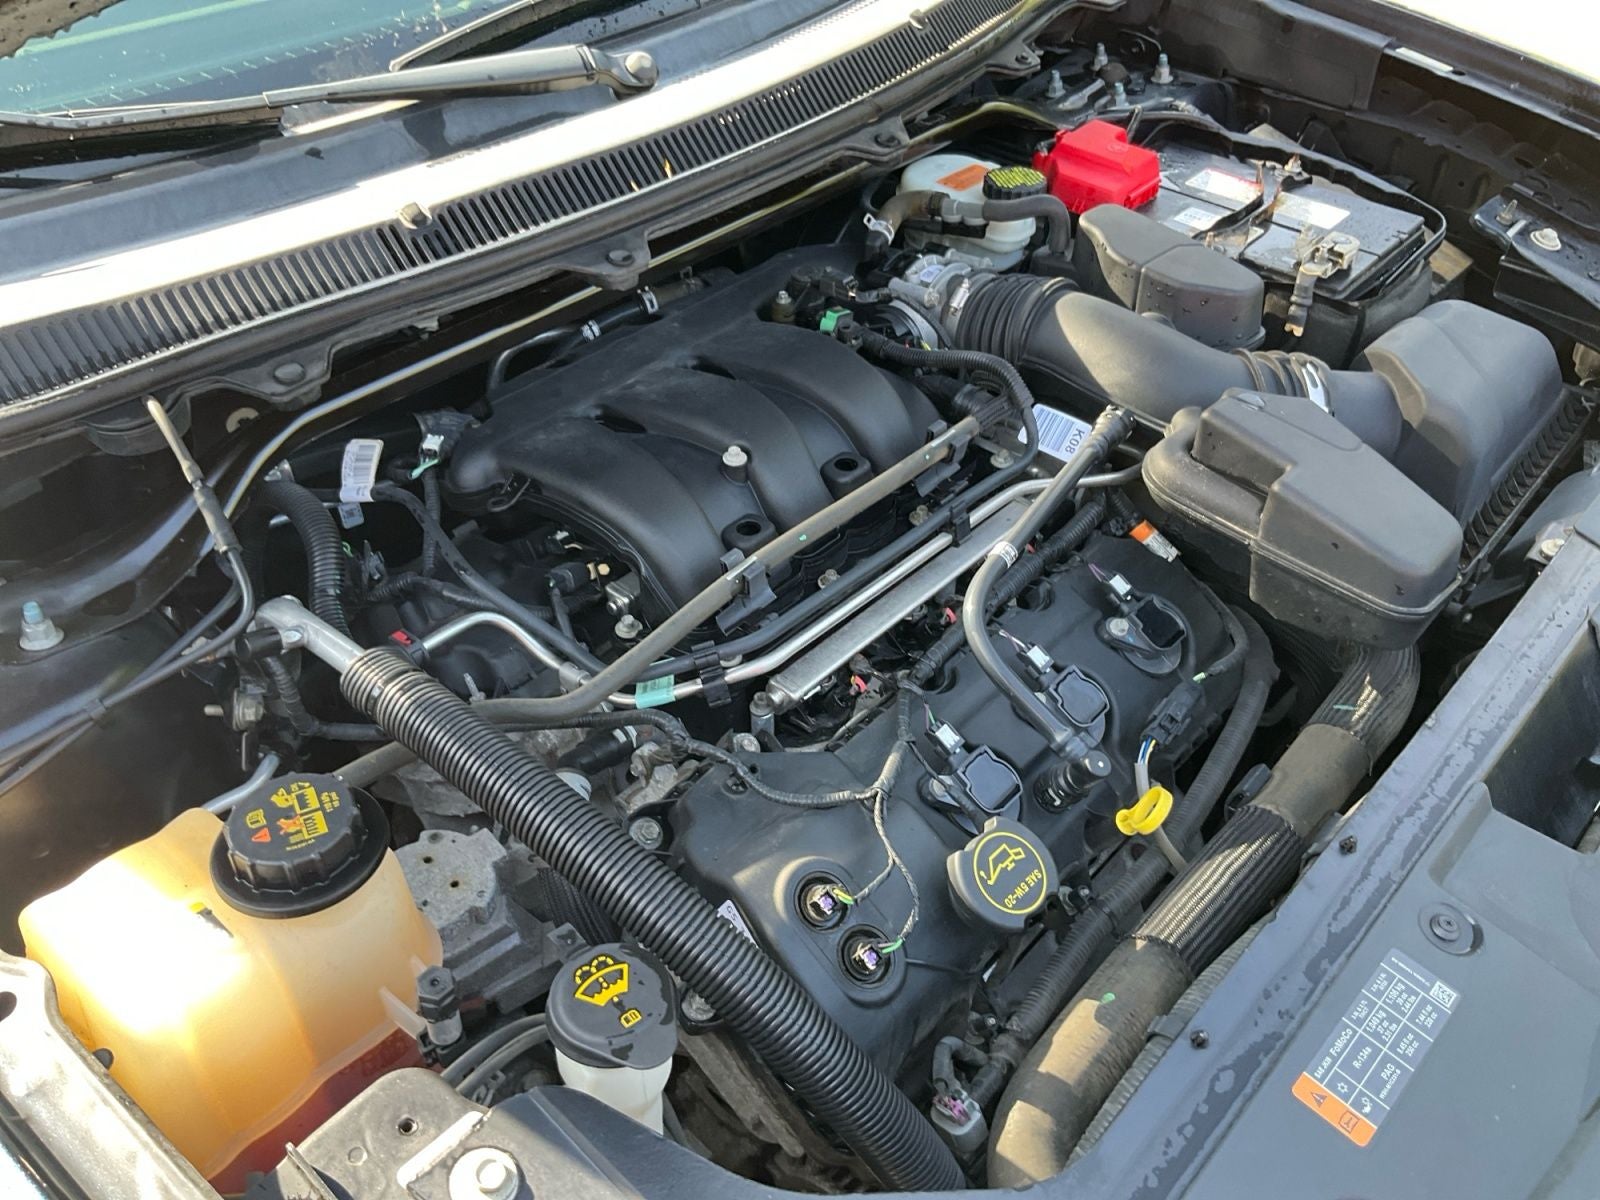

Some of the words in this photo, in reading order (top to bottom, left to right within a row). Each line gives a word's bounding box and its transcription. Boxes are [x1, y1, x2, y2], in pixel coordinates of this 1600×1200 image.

[1065, 428, 1085, 454] K08
[1025, 869, 1042, 887] SAE
[1374, 1008, 1387, 1020] kg
[1328, 1026, 1353, 1056] FoMoCo
[1351, 1044, 1372, 1069] R-134a
[1380, 1061, 1395, 1080] PAG
